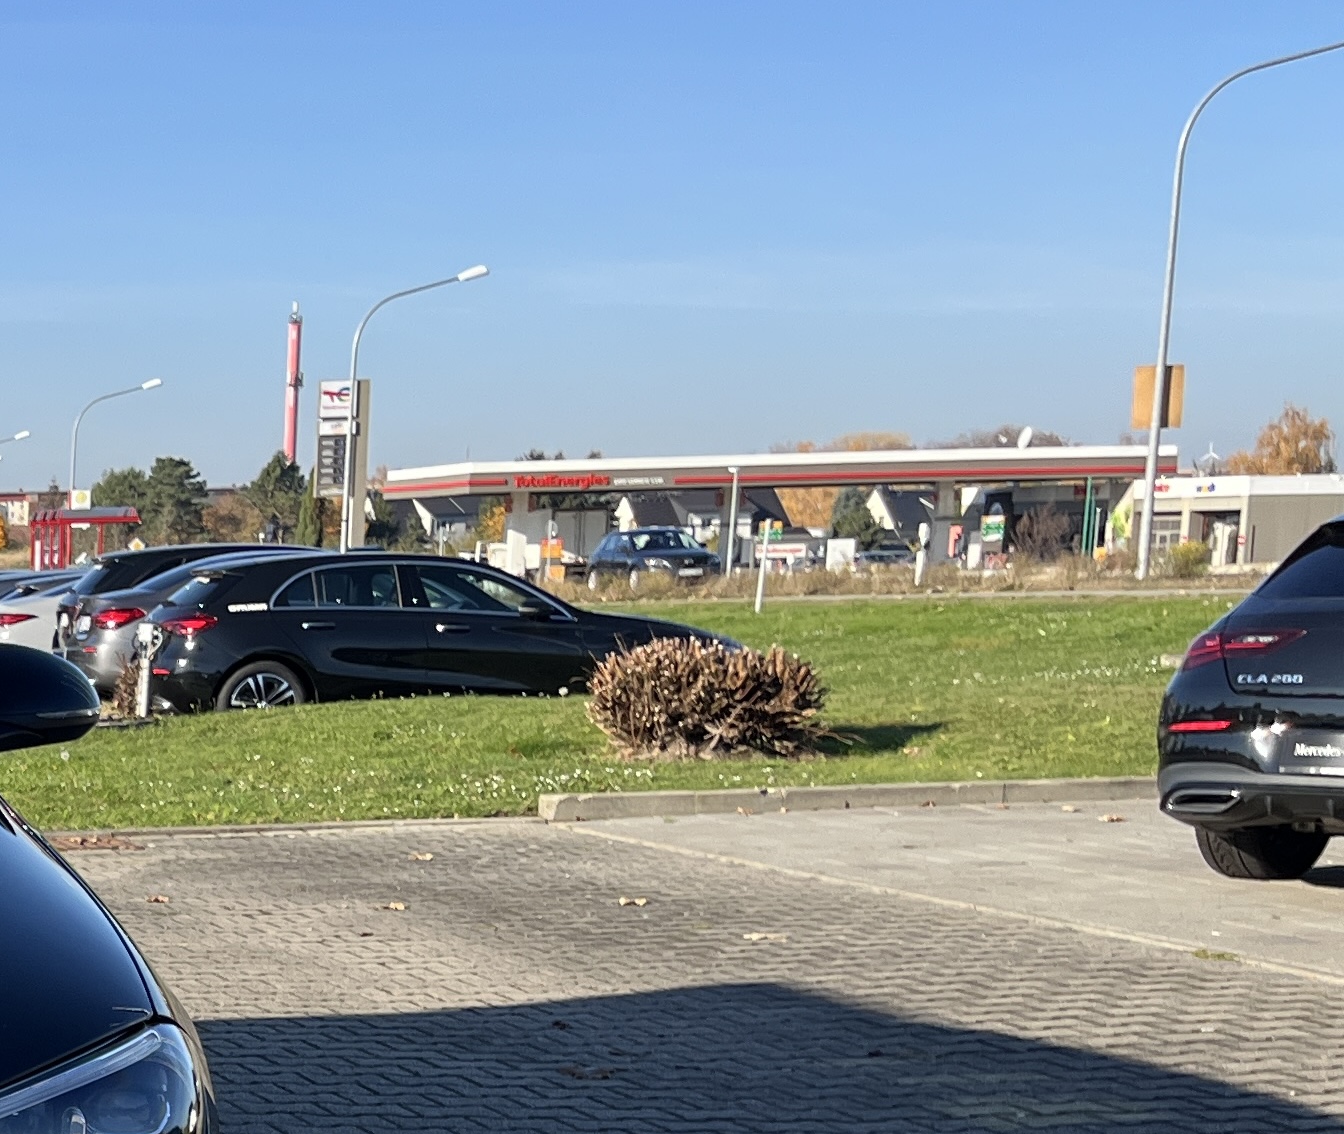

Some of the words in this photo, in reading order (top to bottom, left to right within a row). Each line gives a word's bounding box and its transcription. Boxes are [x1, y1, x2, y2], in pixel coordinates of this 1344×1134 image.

[513, 473, 610, 490] TotalEnergies
[1237, 674, 1268, 684] CLA
[1271, 674, 1303, 684] 200
